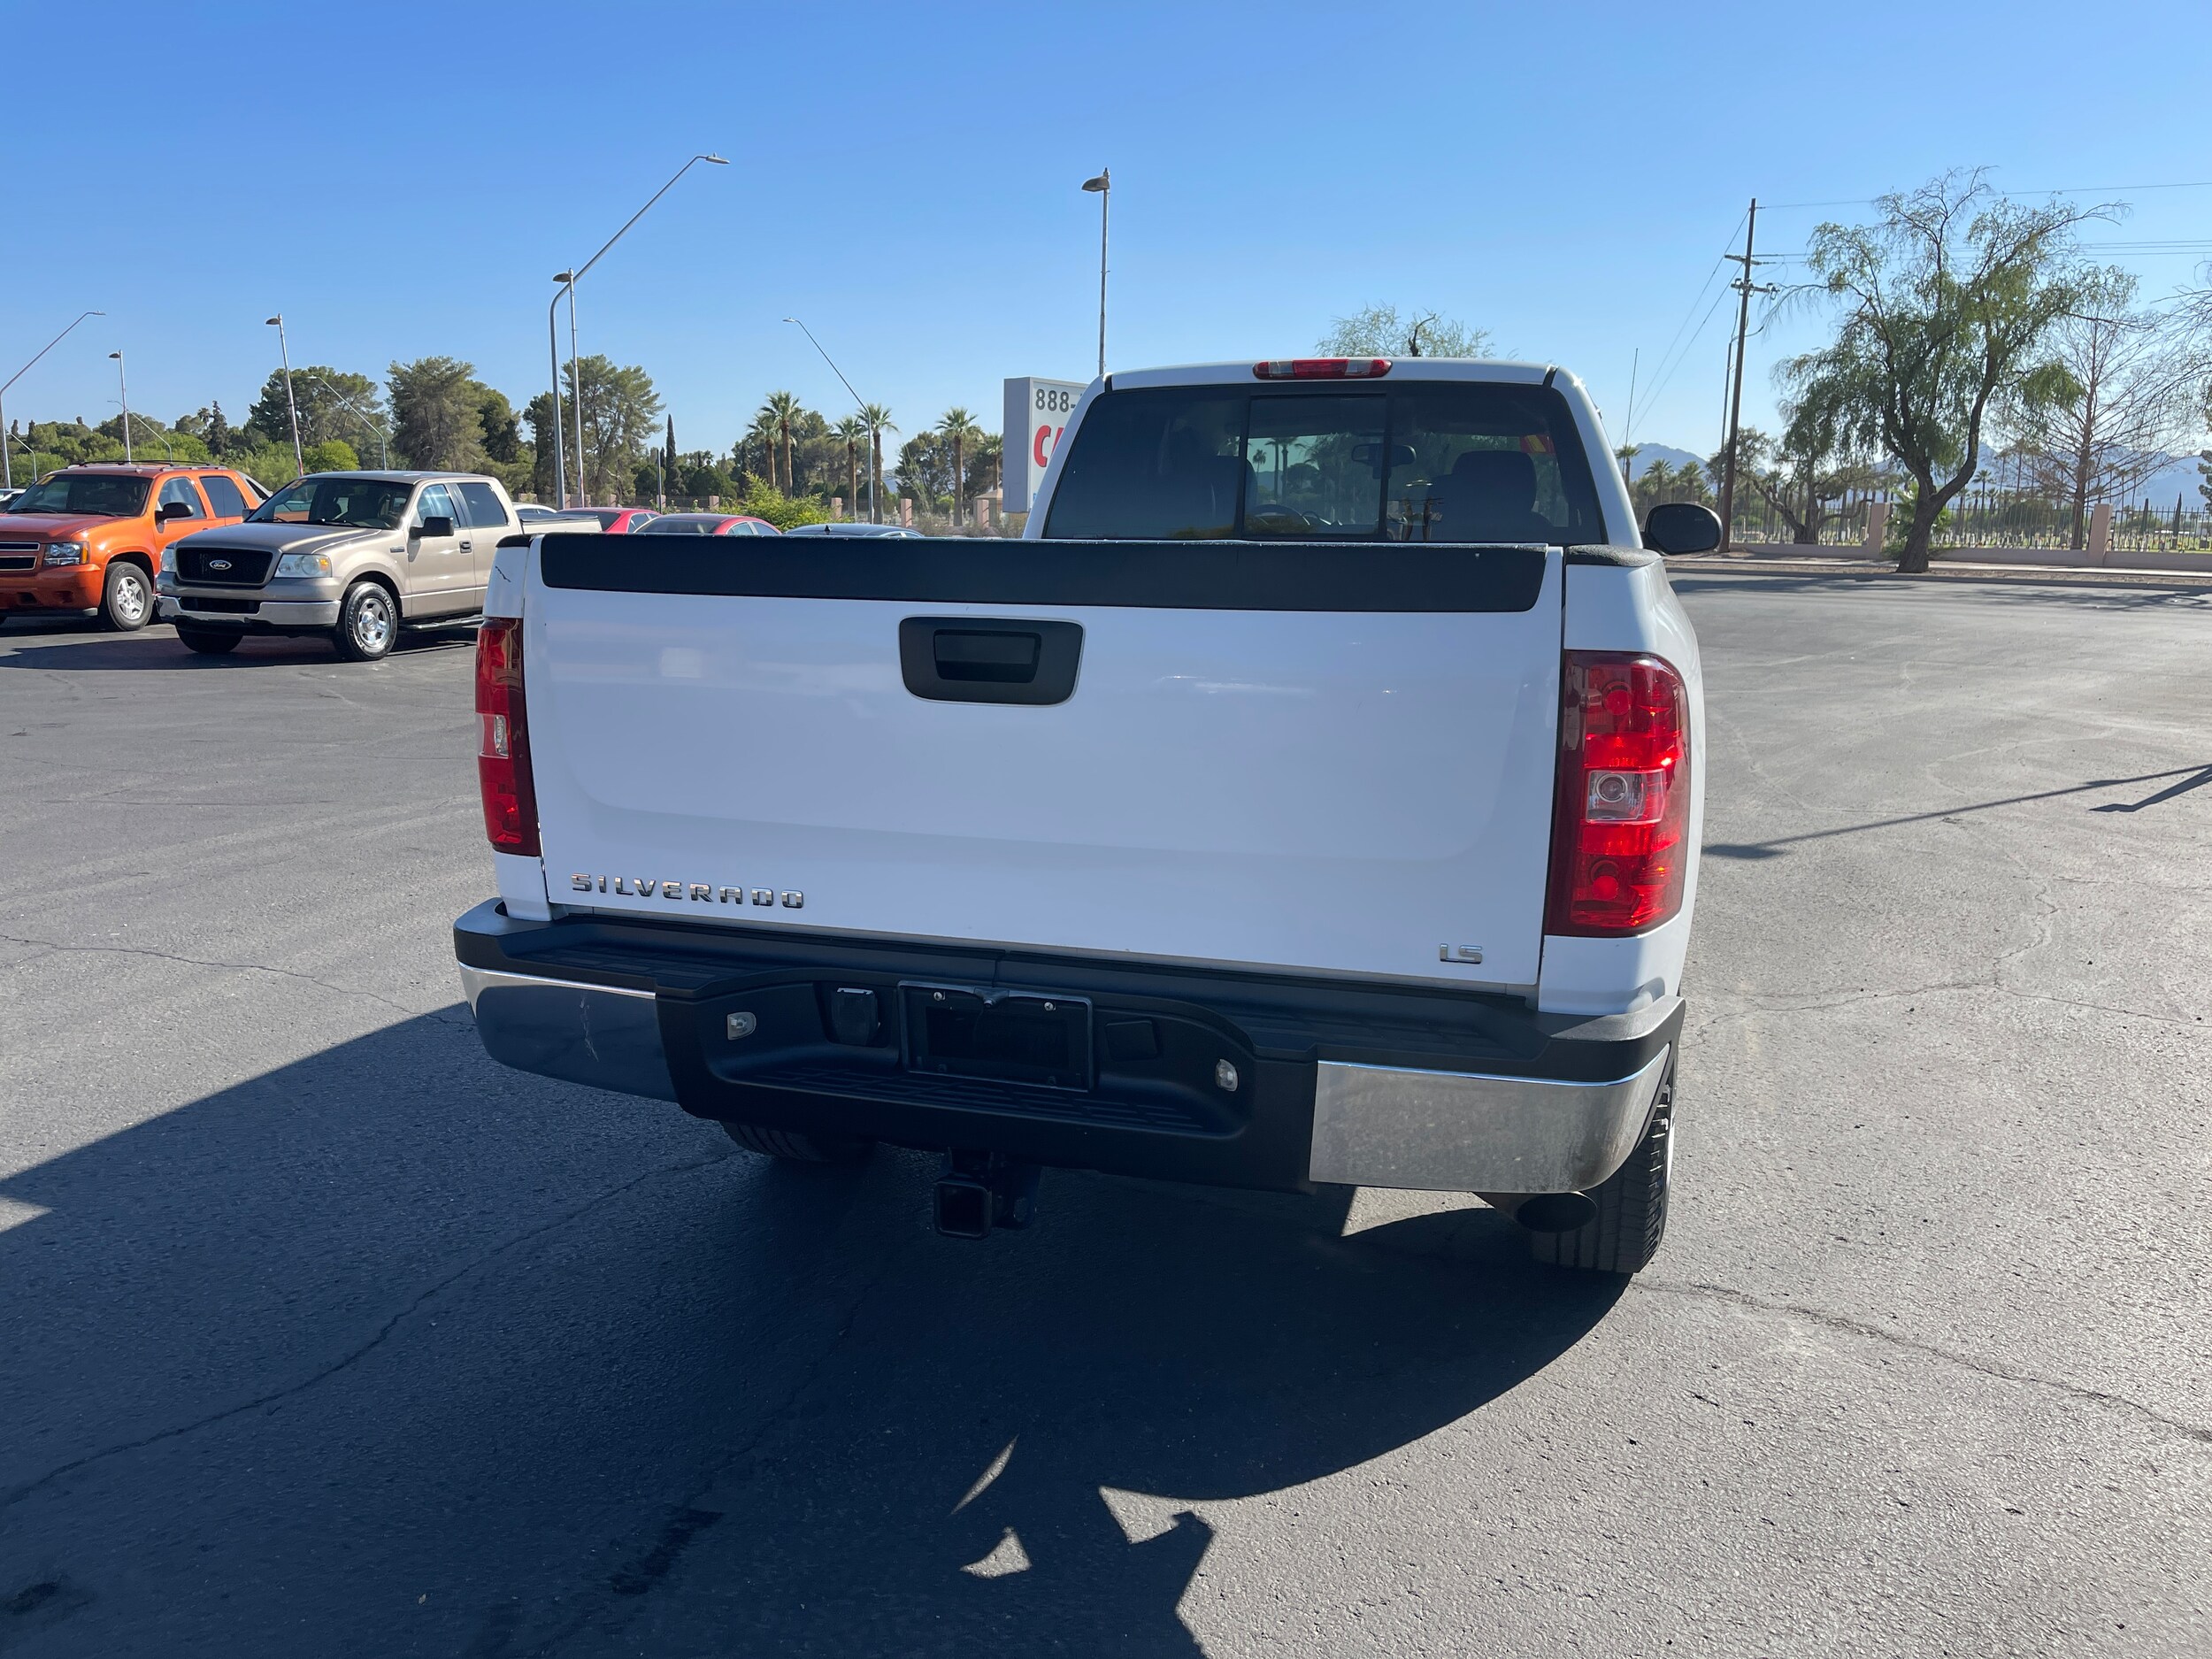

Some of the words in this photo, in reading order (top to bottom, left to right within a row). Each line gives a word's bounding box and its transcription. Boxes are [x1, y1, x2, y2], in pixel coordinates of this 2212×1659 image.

[1035, 388, 1082, 412] 888-
[572, 872, 804, 909] SILVERADO
[1440, 942, 1483, 964] LS
